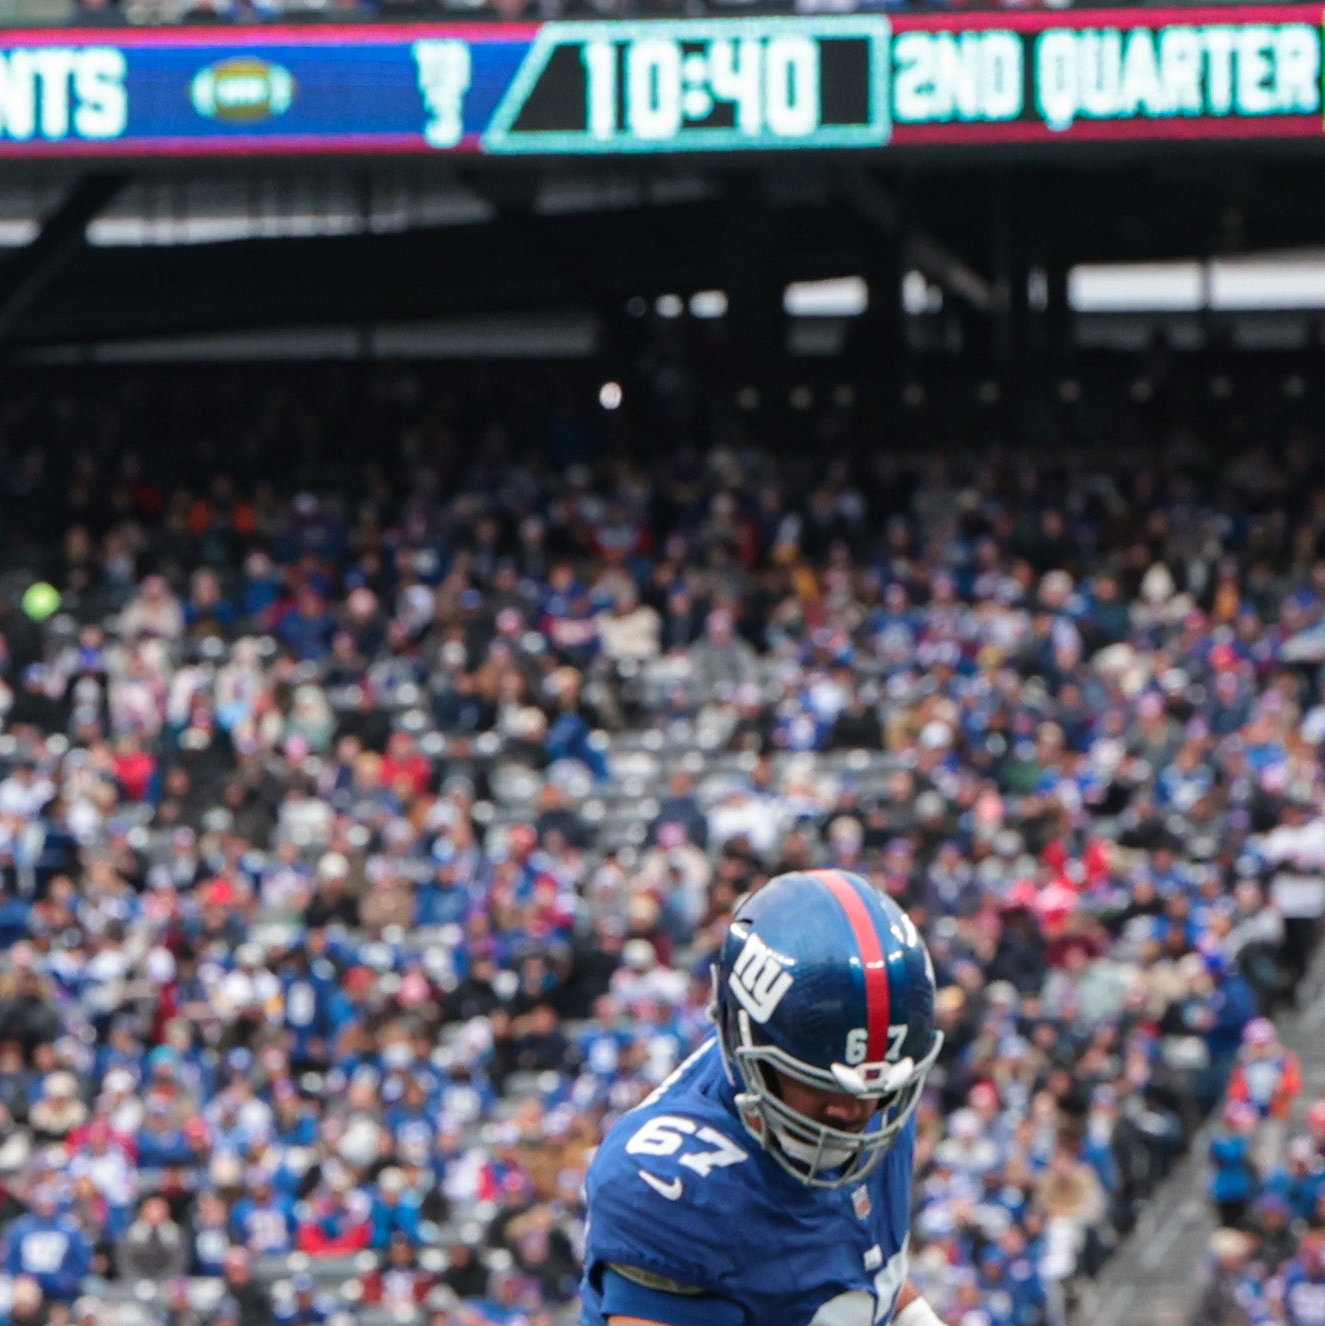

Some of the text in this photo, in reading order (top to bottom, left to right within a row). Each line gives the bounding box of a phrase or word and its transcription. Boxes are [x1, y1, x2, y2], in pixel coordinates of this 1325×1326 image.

[581, 37, 821, 141] 10:40
[892, 22, 1321, 132] 2ND QUARTER
[844, 1024, 908, 1065] 67
[625, 1115, 749, 1177] 67
